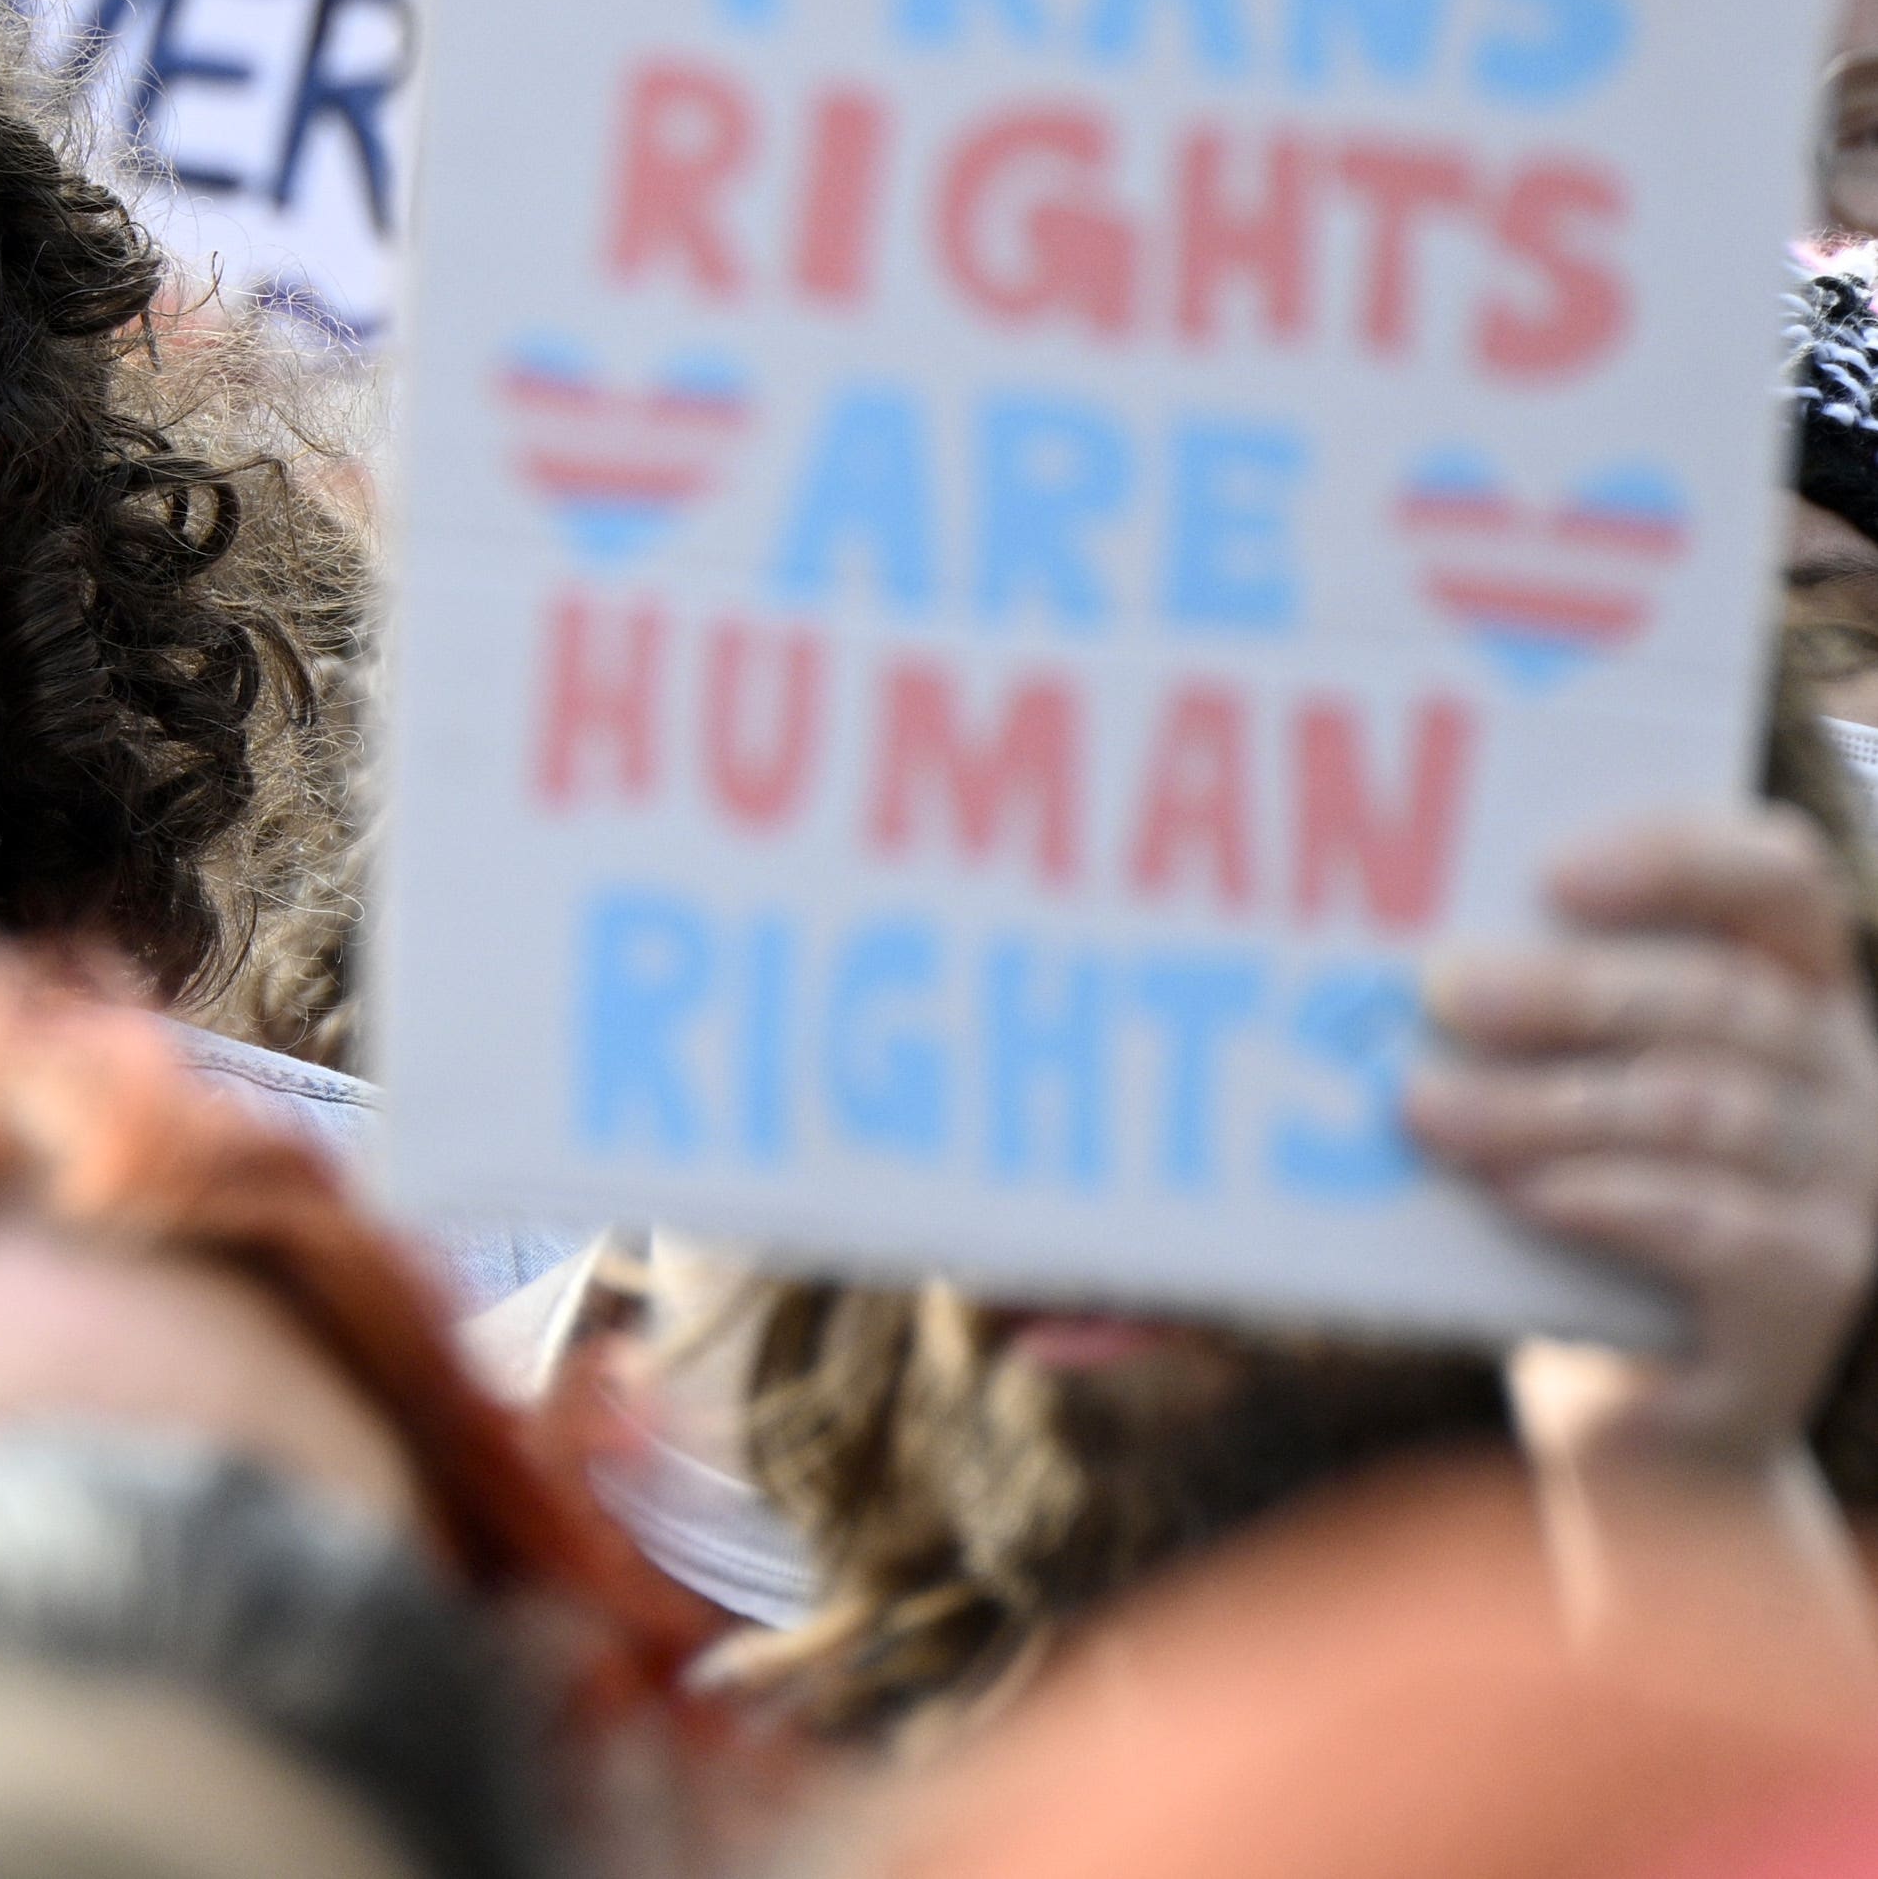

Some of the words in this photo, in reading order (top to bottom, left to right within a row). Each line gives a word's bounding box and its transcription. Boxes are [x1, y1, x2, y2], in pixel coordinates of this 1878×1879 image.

[605, 62, 1635, 386] RIGHTS
[777, 388, 1307, 632] ARE
[535, 592, 1479, 934] HUMAN
[577, 890, 1425, 1202] RIGHTS
